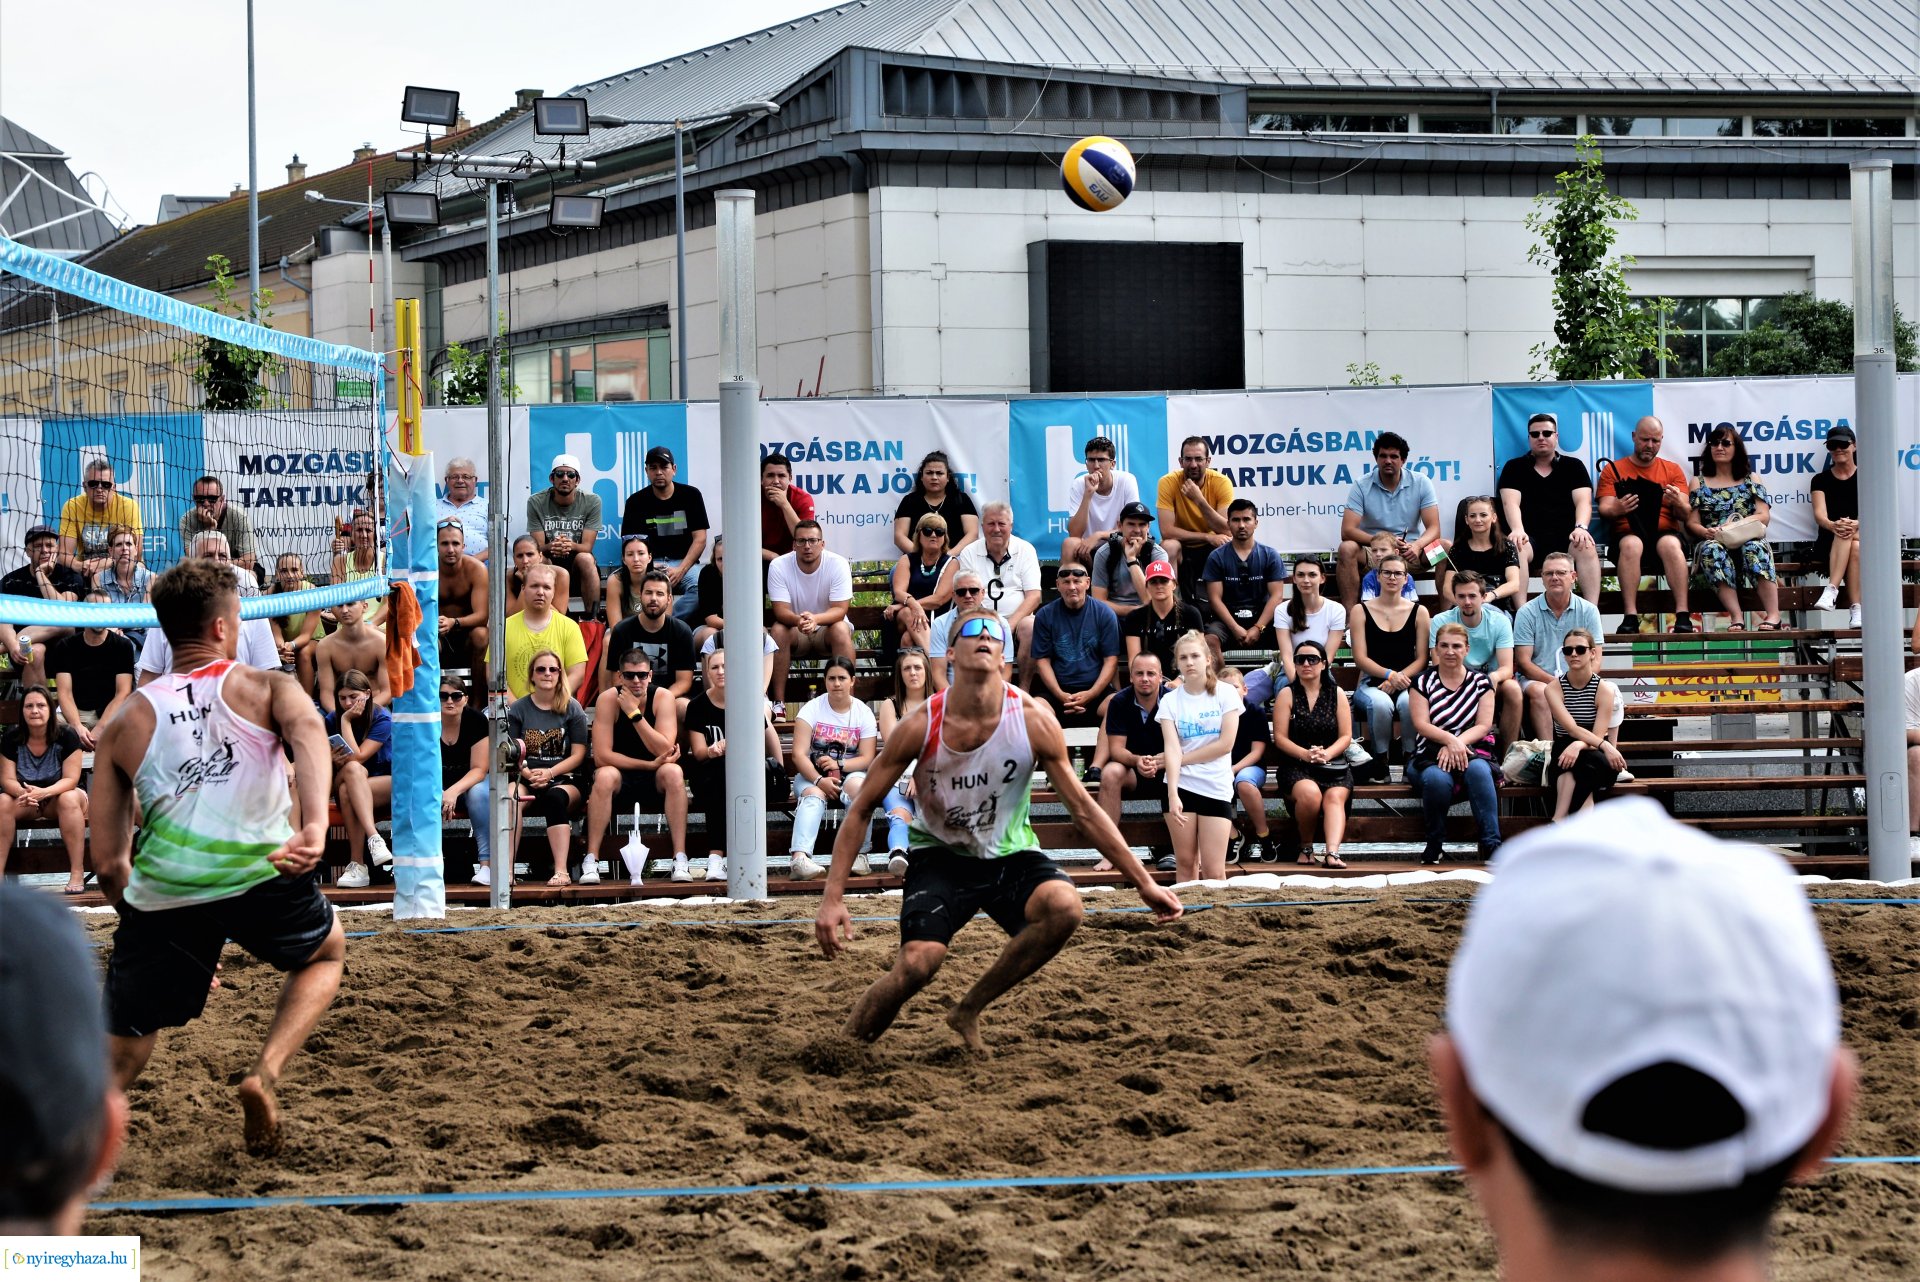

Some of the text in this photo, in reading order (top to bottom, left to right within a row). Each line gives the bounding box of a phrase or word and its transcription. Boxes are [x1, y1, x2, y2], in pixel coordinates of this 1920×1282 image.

[1688, 415, 1850, 443] MZGÁSB
[851, 473, 872, 494] A
[1212, 465, 1326, 488] ARTJUK
[1333, 464, 1353, 485] A
[239, 485, 365, 508] TARTJUK
[169, 703, 212, 725] HUN
[1199, 710, 1220, 719] 2023
[820, 726, 858, 742] PUNA
[951, 759, 1018, 790] HUN 2
